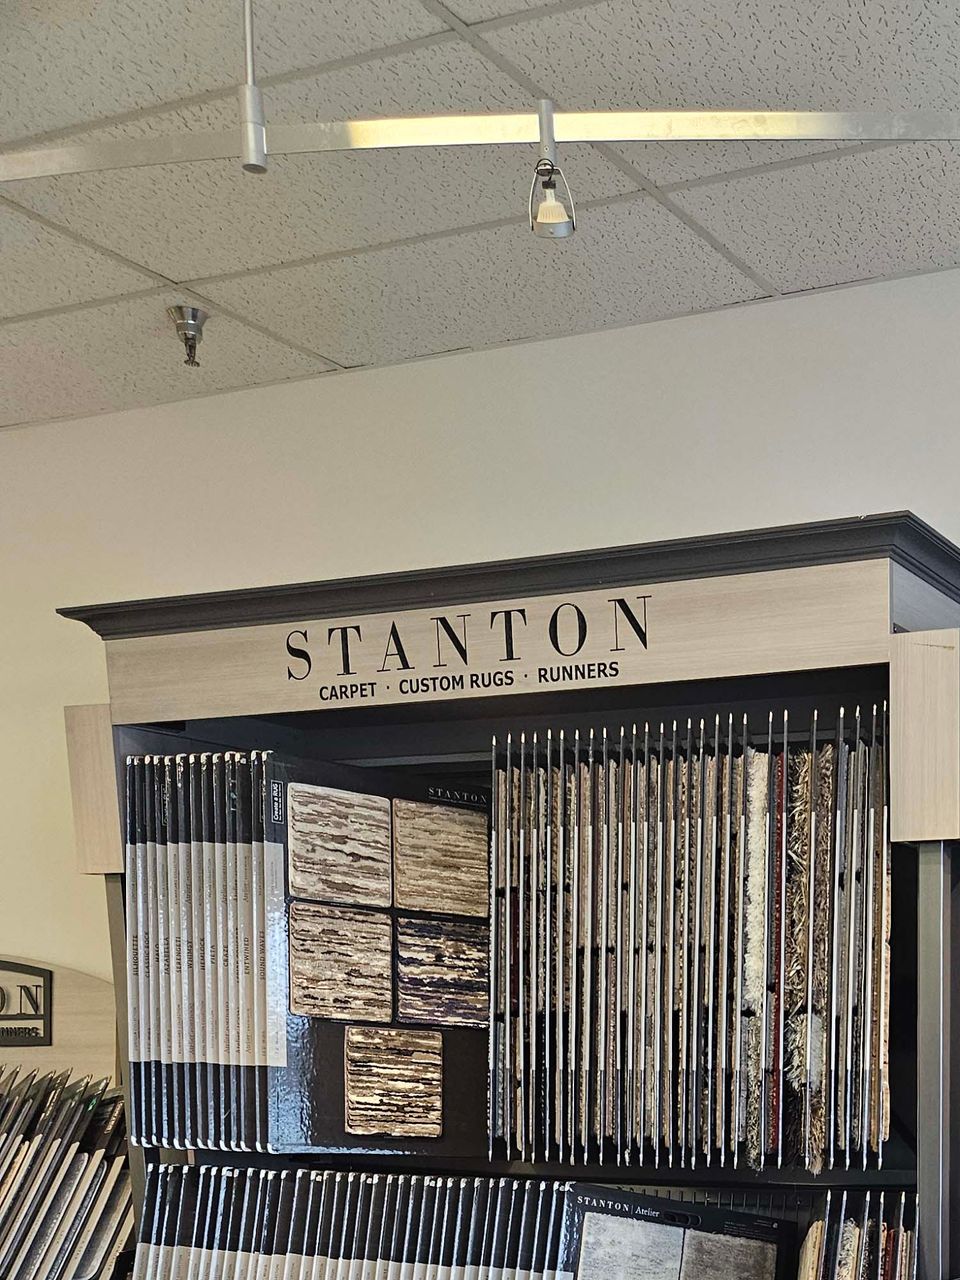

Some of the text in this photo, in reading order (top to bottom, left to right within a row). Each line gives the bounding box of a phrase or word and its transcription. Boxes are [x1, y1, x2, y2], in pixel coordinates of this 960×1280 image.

[286, 595, 652, 681] STANTON
[319, 661, 619, 701] CARPET CUSTOM RUGS RUNNERS
[428, 787, 488, 804] STANTON
[577, 1196, 661, 1218] STANTON Atelier
